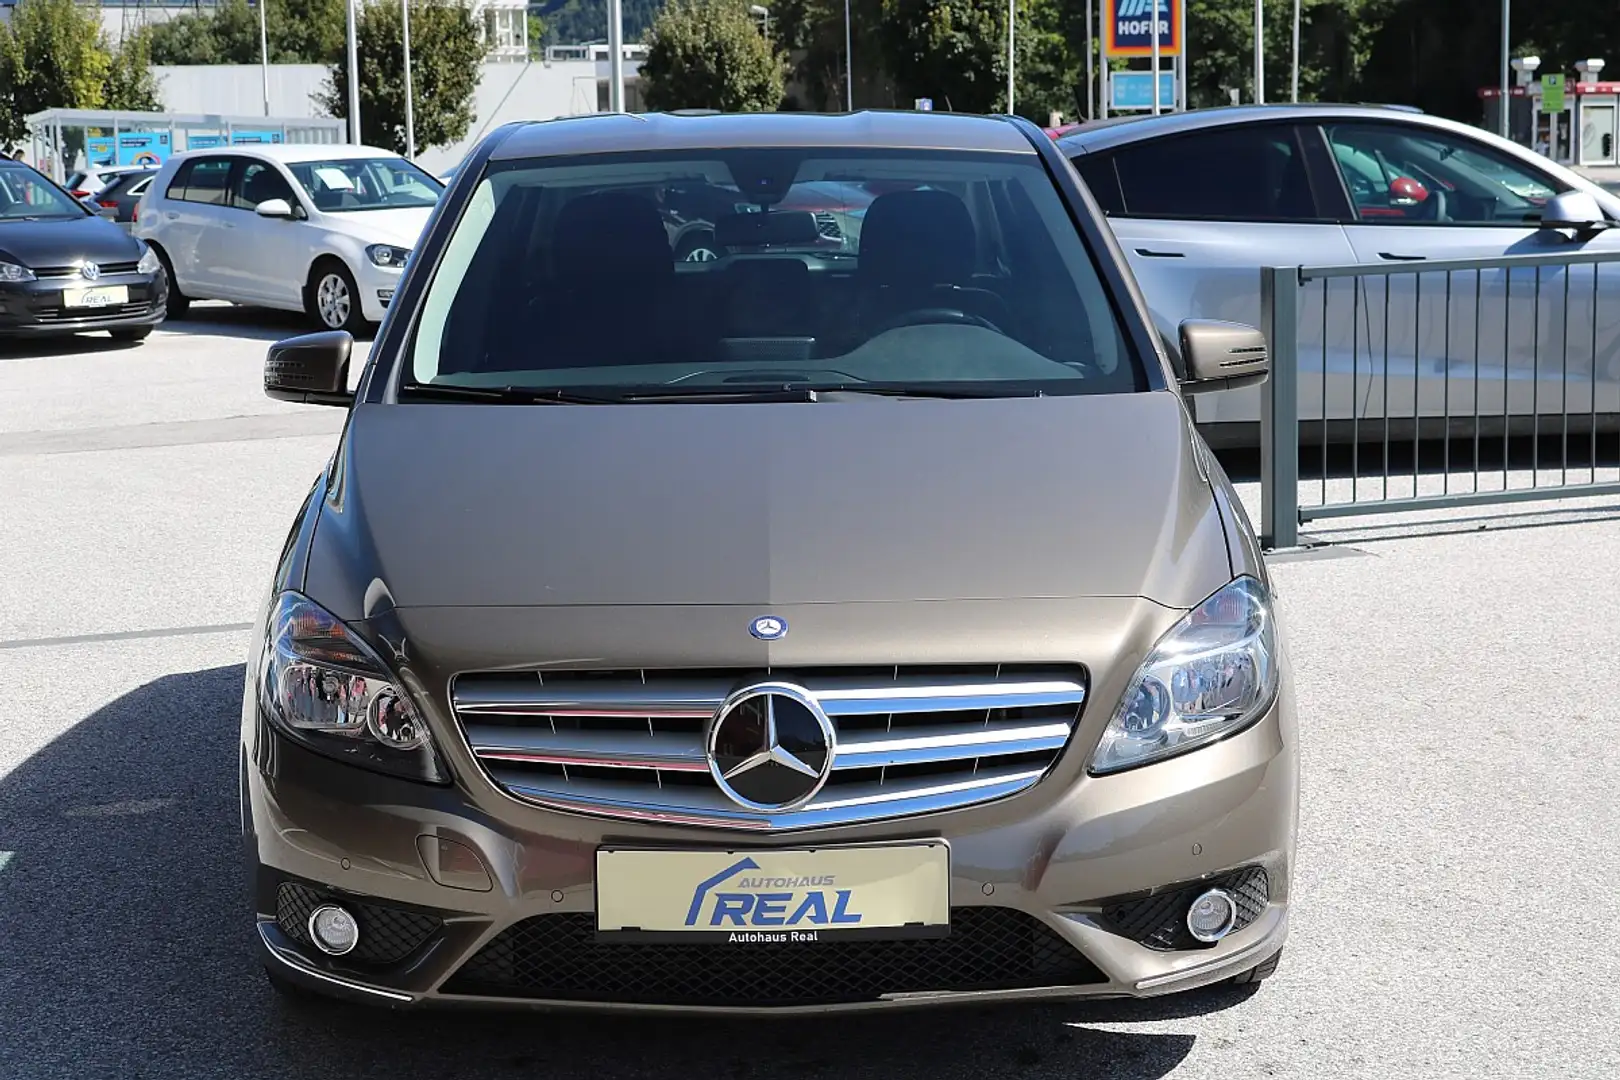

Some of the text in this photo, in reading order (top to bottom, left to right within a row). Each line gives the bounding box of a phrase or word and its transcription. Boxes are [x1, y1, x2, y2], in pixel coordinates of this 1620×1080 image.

[737, 875, 835, 888] AUTOHAUS
[710, 890, 862, 926] REAL
[728, 931, 818, 943] Autohaus Real
